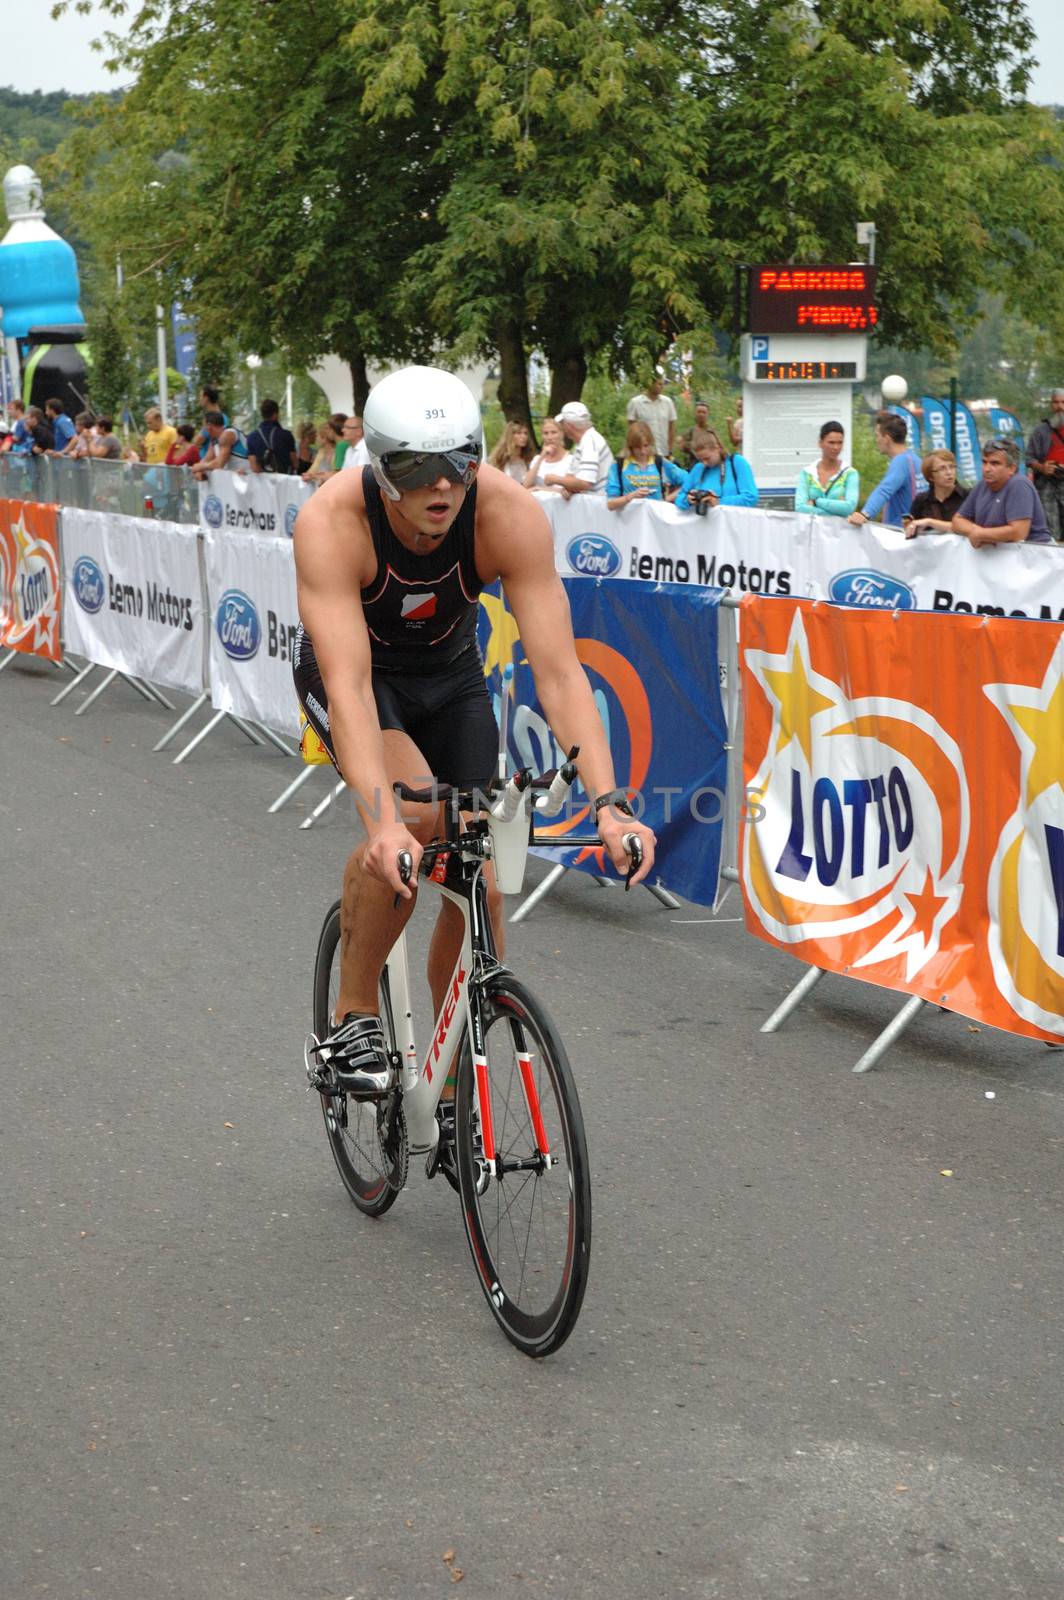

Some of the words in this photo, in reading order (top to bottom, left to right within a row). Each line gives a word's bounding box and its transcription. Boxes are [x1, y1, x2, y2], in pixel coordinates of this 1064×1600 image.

[760, 271, 866, 291] PARKING
[425, 408, 446, 420] 391
[421, 438, 456, 450] GIRO
[576, 538, 611, 573] Ford
[697, 554, 791, 595] Motors
[146, 580, 193, 632] Motors
[845, 575, 898, 609] Ford
[220, 600, 253, 650] Ford
[775, 766, 915, 888] LOTTO
[421, 956, 467, 1085] TREK
